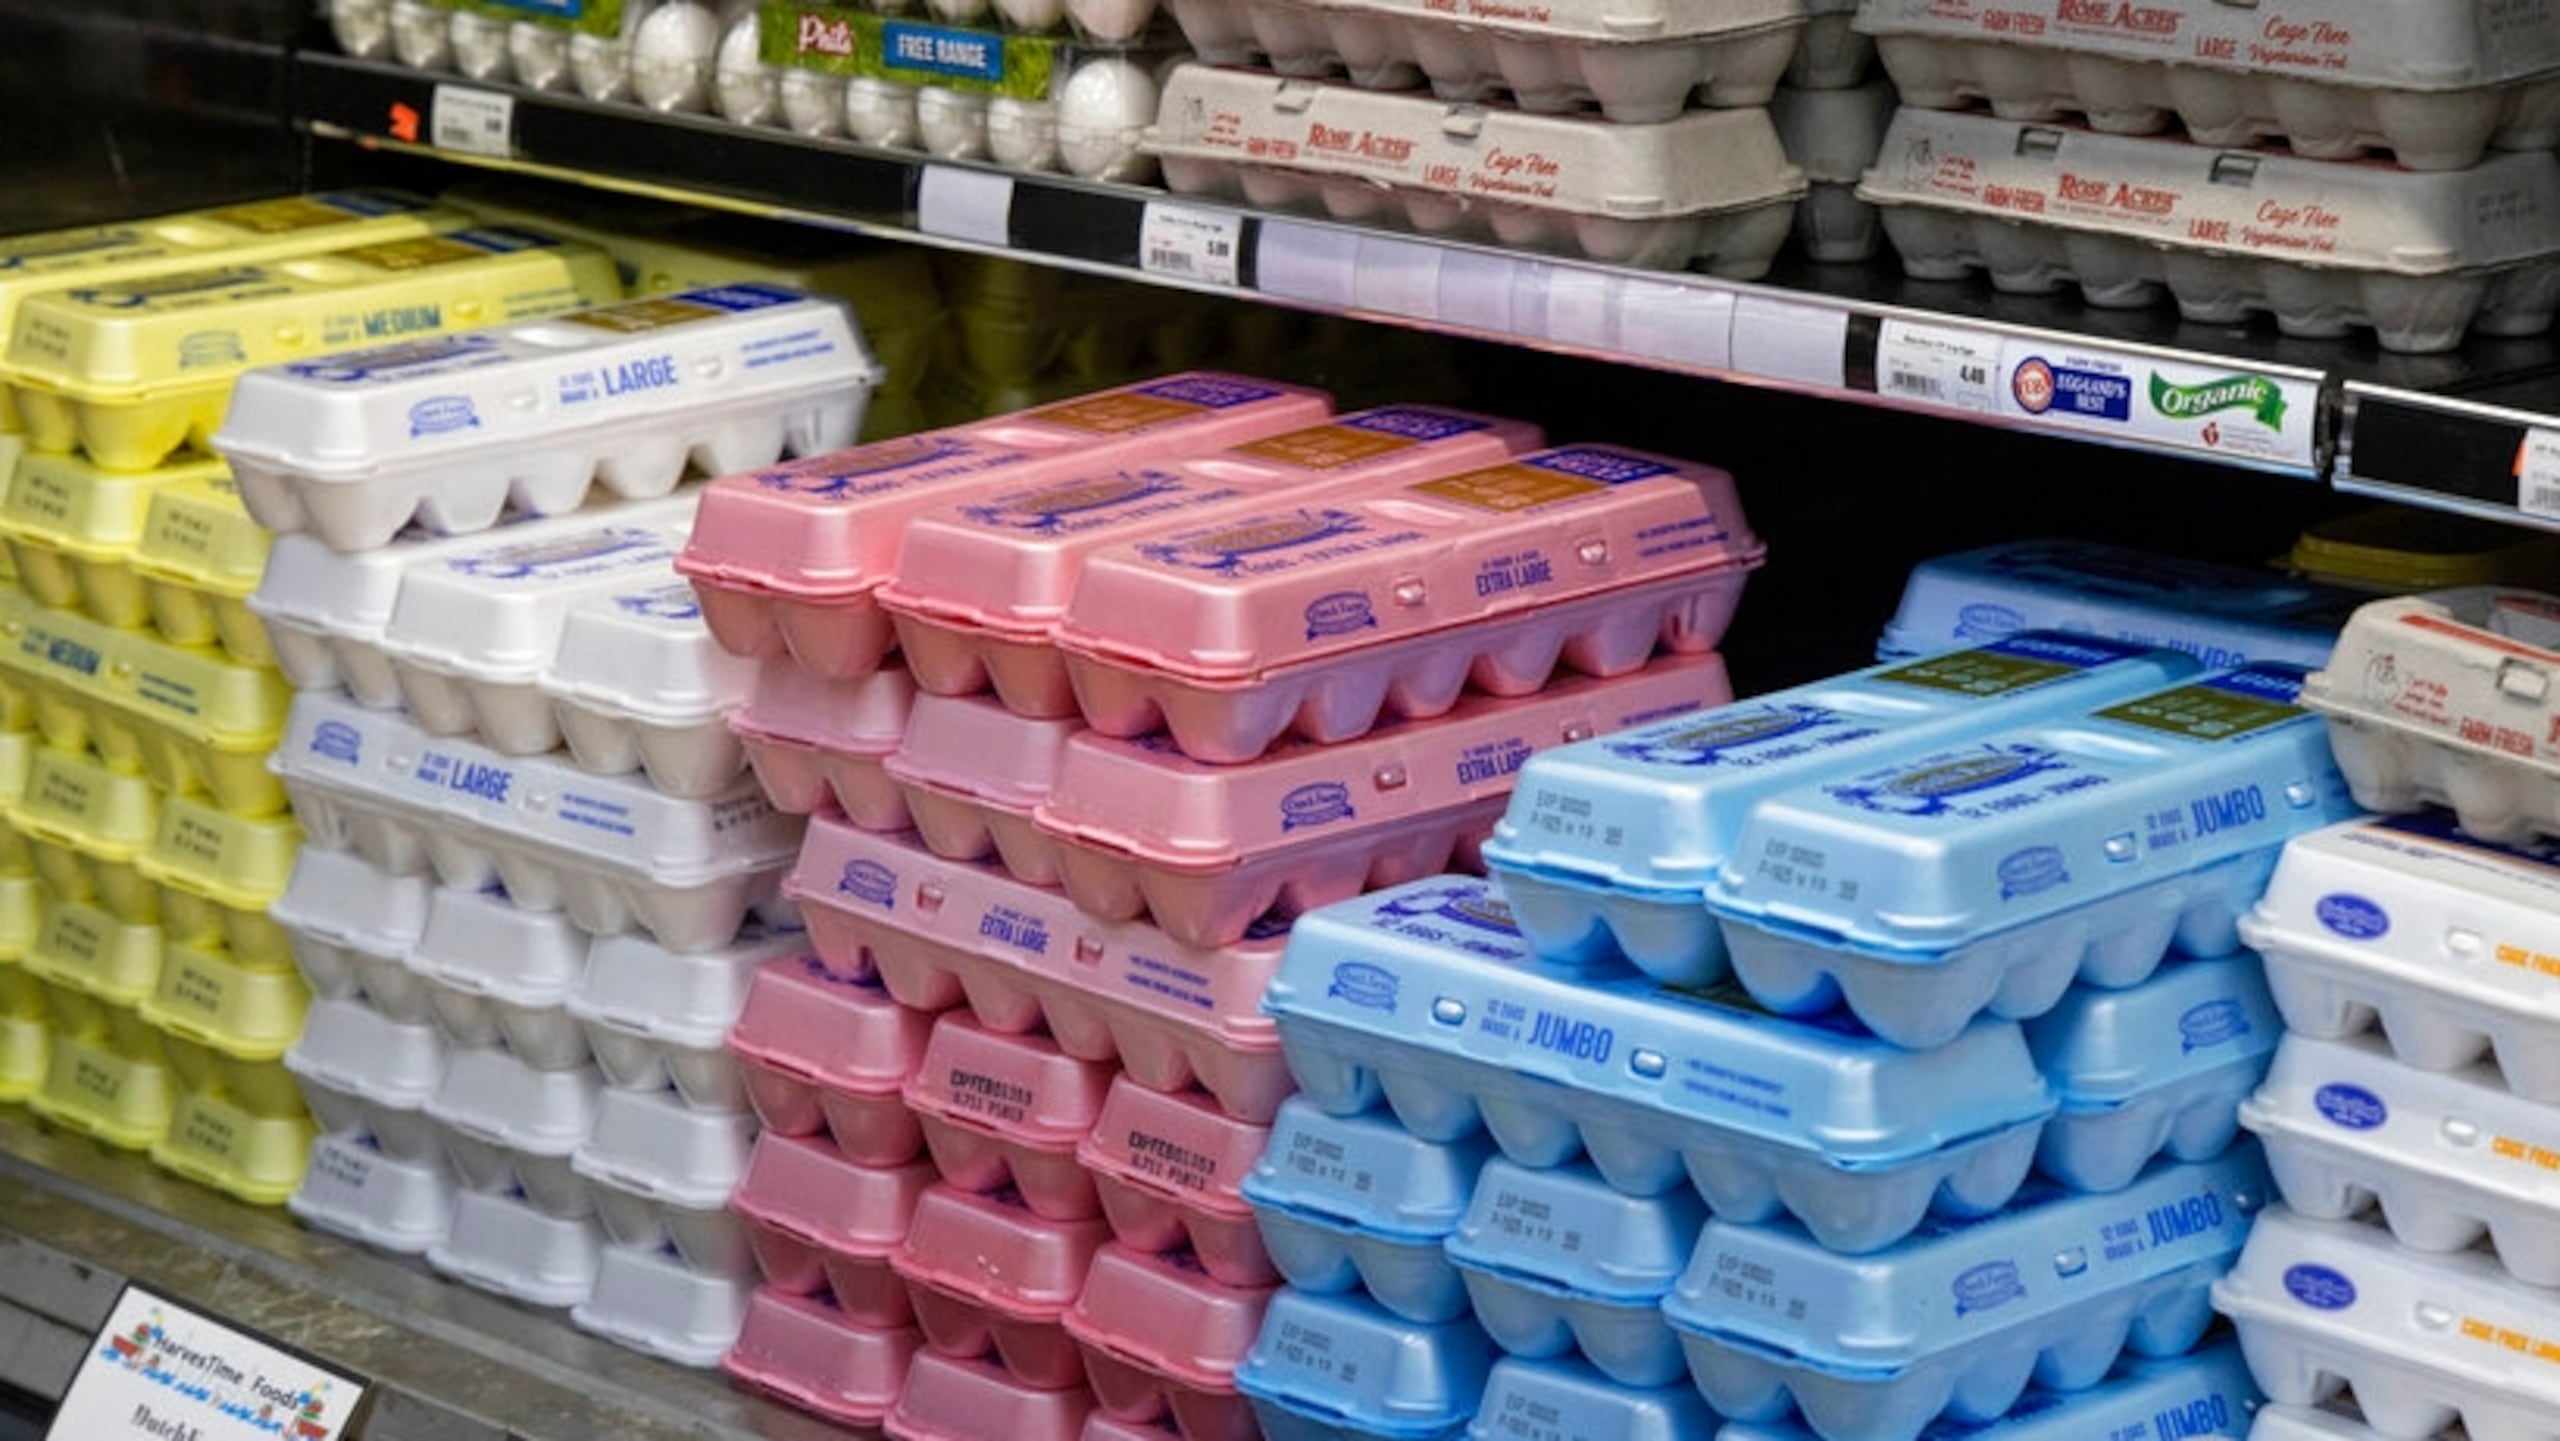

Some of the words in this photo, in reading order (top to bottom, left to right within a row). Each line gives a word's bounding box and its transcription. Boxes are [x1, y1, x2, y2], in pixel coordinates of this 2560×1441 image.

[2264, 15, 2309, 44] Cage
[2312, 22, 2350, 44] Free
[898, 33, 934, 60] FREE
[936, 36, 988, 69] RANGE
[2195, 36, 2238, 60] LARGE
[1306, 123, 1353, 152] ROSE
[1423, 163, 1461, 187] LARGE
[1484, 148, 1521, 176] Cage
[1524, 156, 1560, 176] Free
[2058, 172, 2110, 202] ROSE
[2256, 200, 2301, 228] Cage
[2304, 206, 2339, 228] Free
[2189, 219, 2230, 244] LARGE
[364, 305, 443, 335] MEDIUM
[601, 355, 678, 395] LARGE
[2075, 393, 2106, 411] BEST
[2161, 381, 2268, 413] Organic
[1475, 571, 1513, 597] EXTRA
[1513, 560, 1554, 588] LARGE
[449, 759, 513, 803] LARGE
[1457, 758, 1496, 784] EXTRA
[2190, 784, 2266, 837] JUMBO
[980, 914, 1013, 942] EXTRA
[1013, 926, 1050, 955] LARGE
[1528, 1010, 1614, 1063] JUMBO
[2146, 1191, 2223, 1248] JUMBO
[153, 1334, 244, 1386] HarvesTime
[251, 1374, 299, 1410] Foods
[2154, 1393, 2230, 1441] JUMBO
